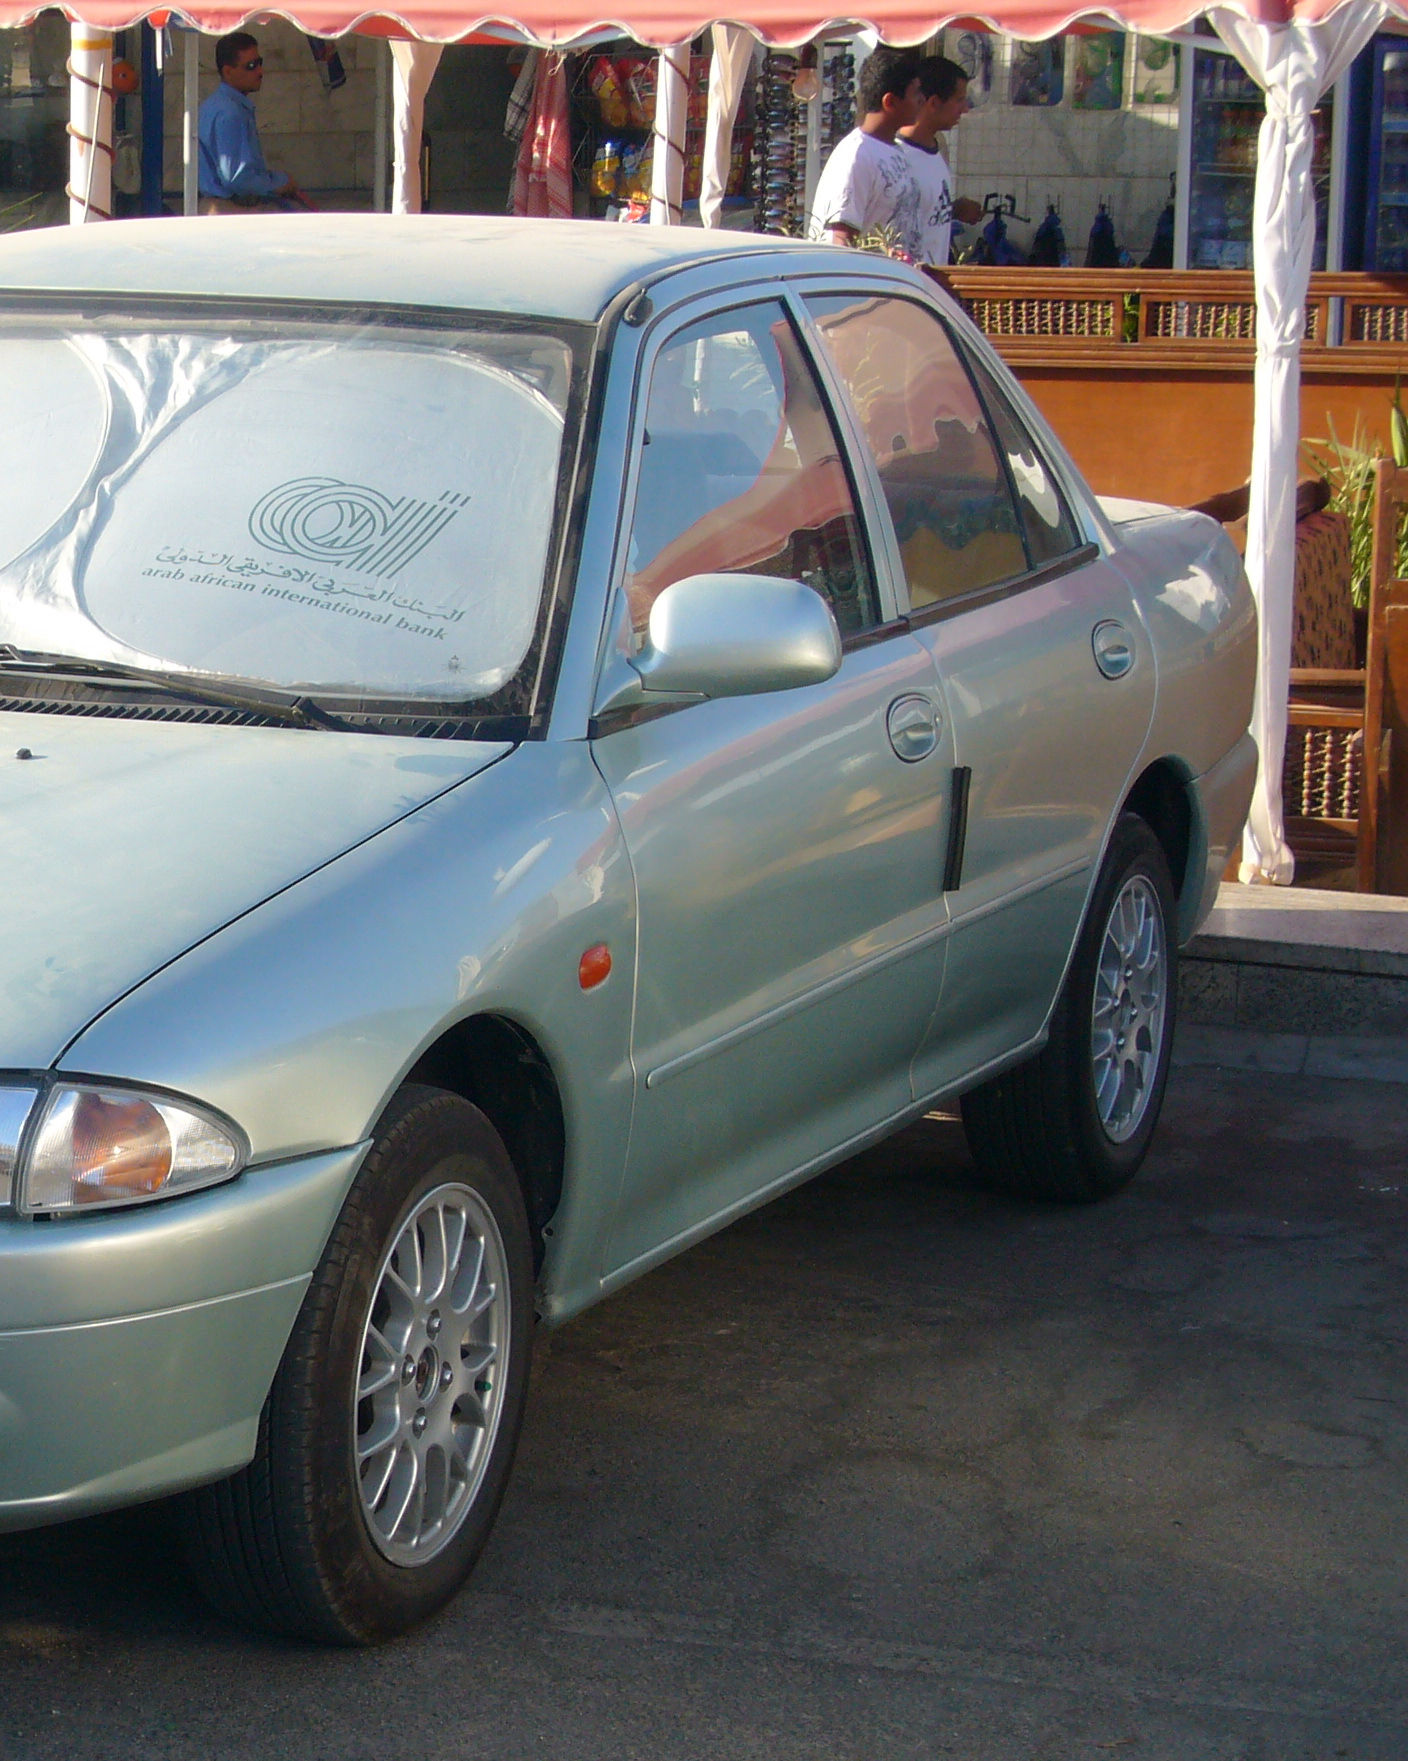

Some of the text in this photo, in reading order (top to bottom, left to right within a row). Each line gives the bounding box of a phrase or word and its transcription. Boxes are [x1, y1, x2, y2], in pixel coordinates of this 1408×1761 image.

[141, 568, 449, 640] arab african international bank
